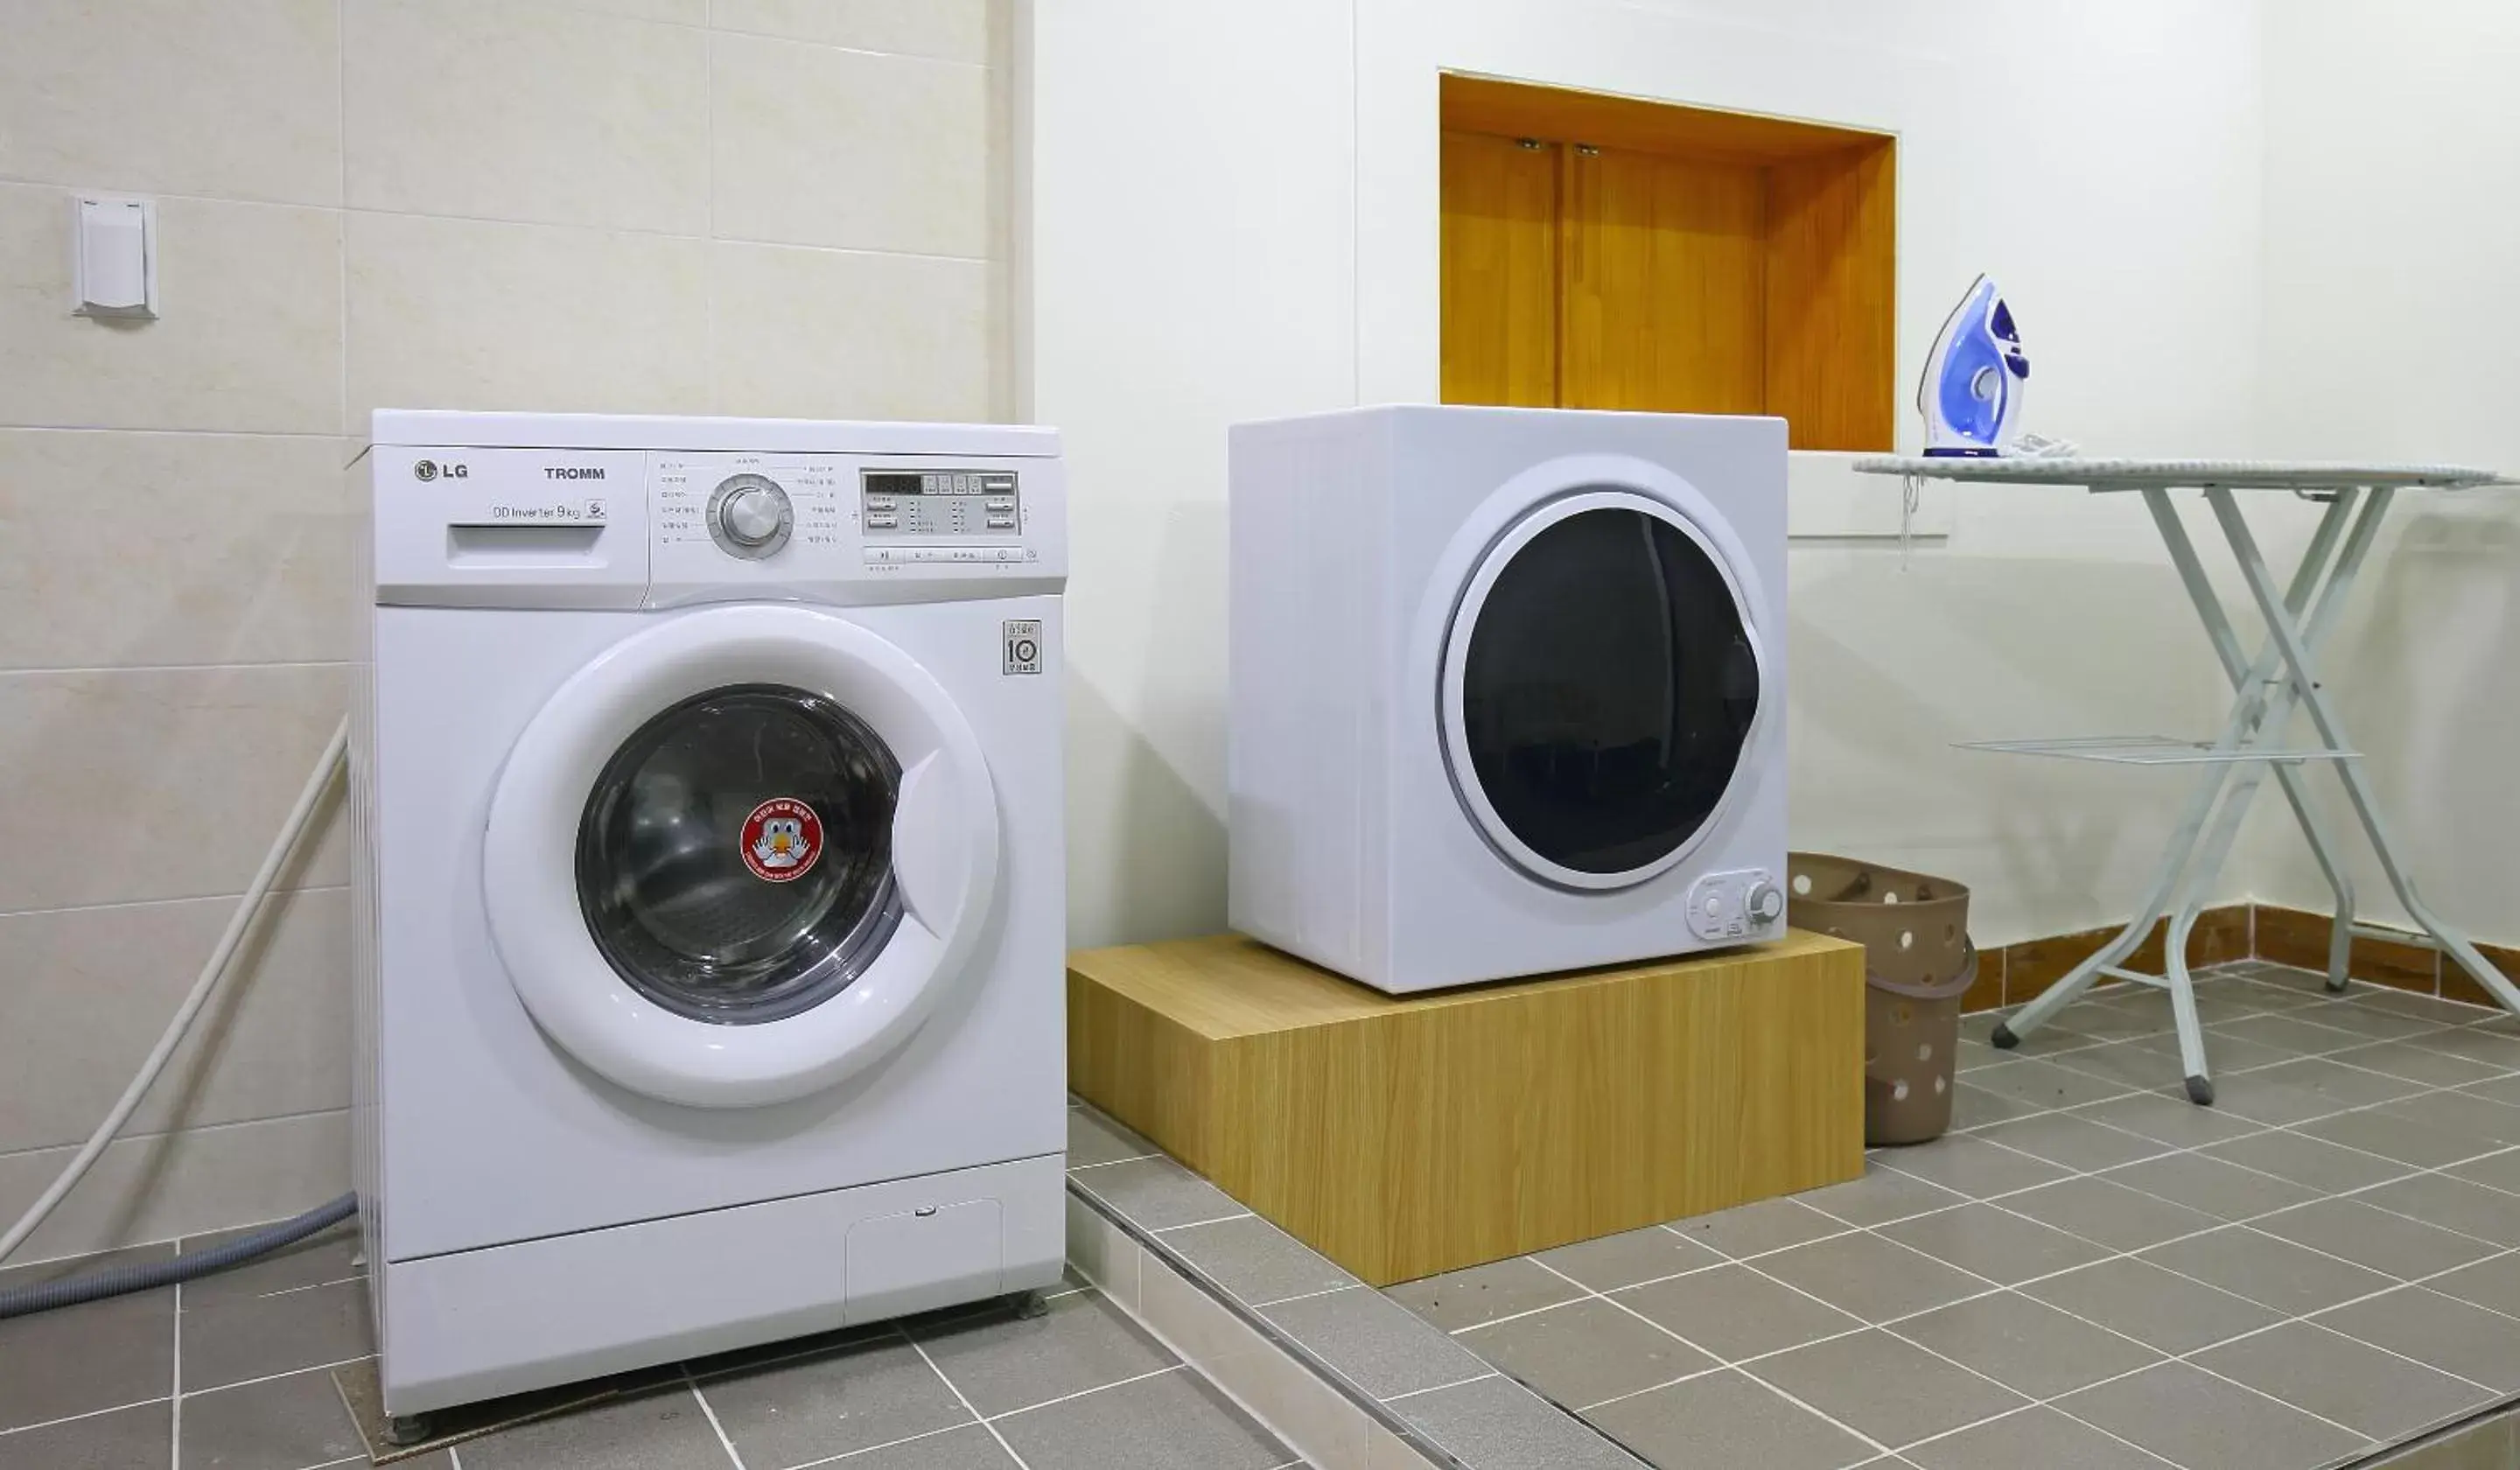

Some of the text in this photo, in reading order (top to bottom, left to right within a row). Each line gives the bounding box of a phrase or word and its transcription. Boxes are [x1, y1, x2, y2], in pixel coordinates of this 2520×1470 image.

[443, 465, 468, 478] LG
[544, 468, 606, 480] TROMM
[512, 507, 554, 518] Inverter
